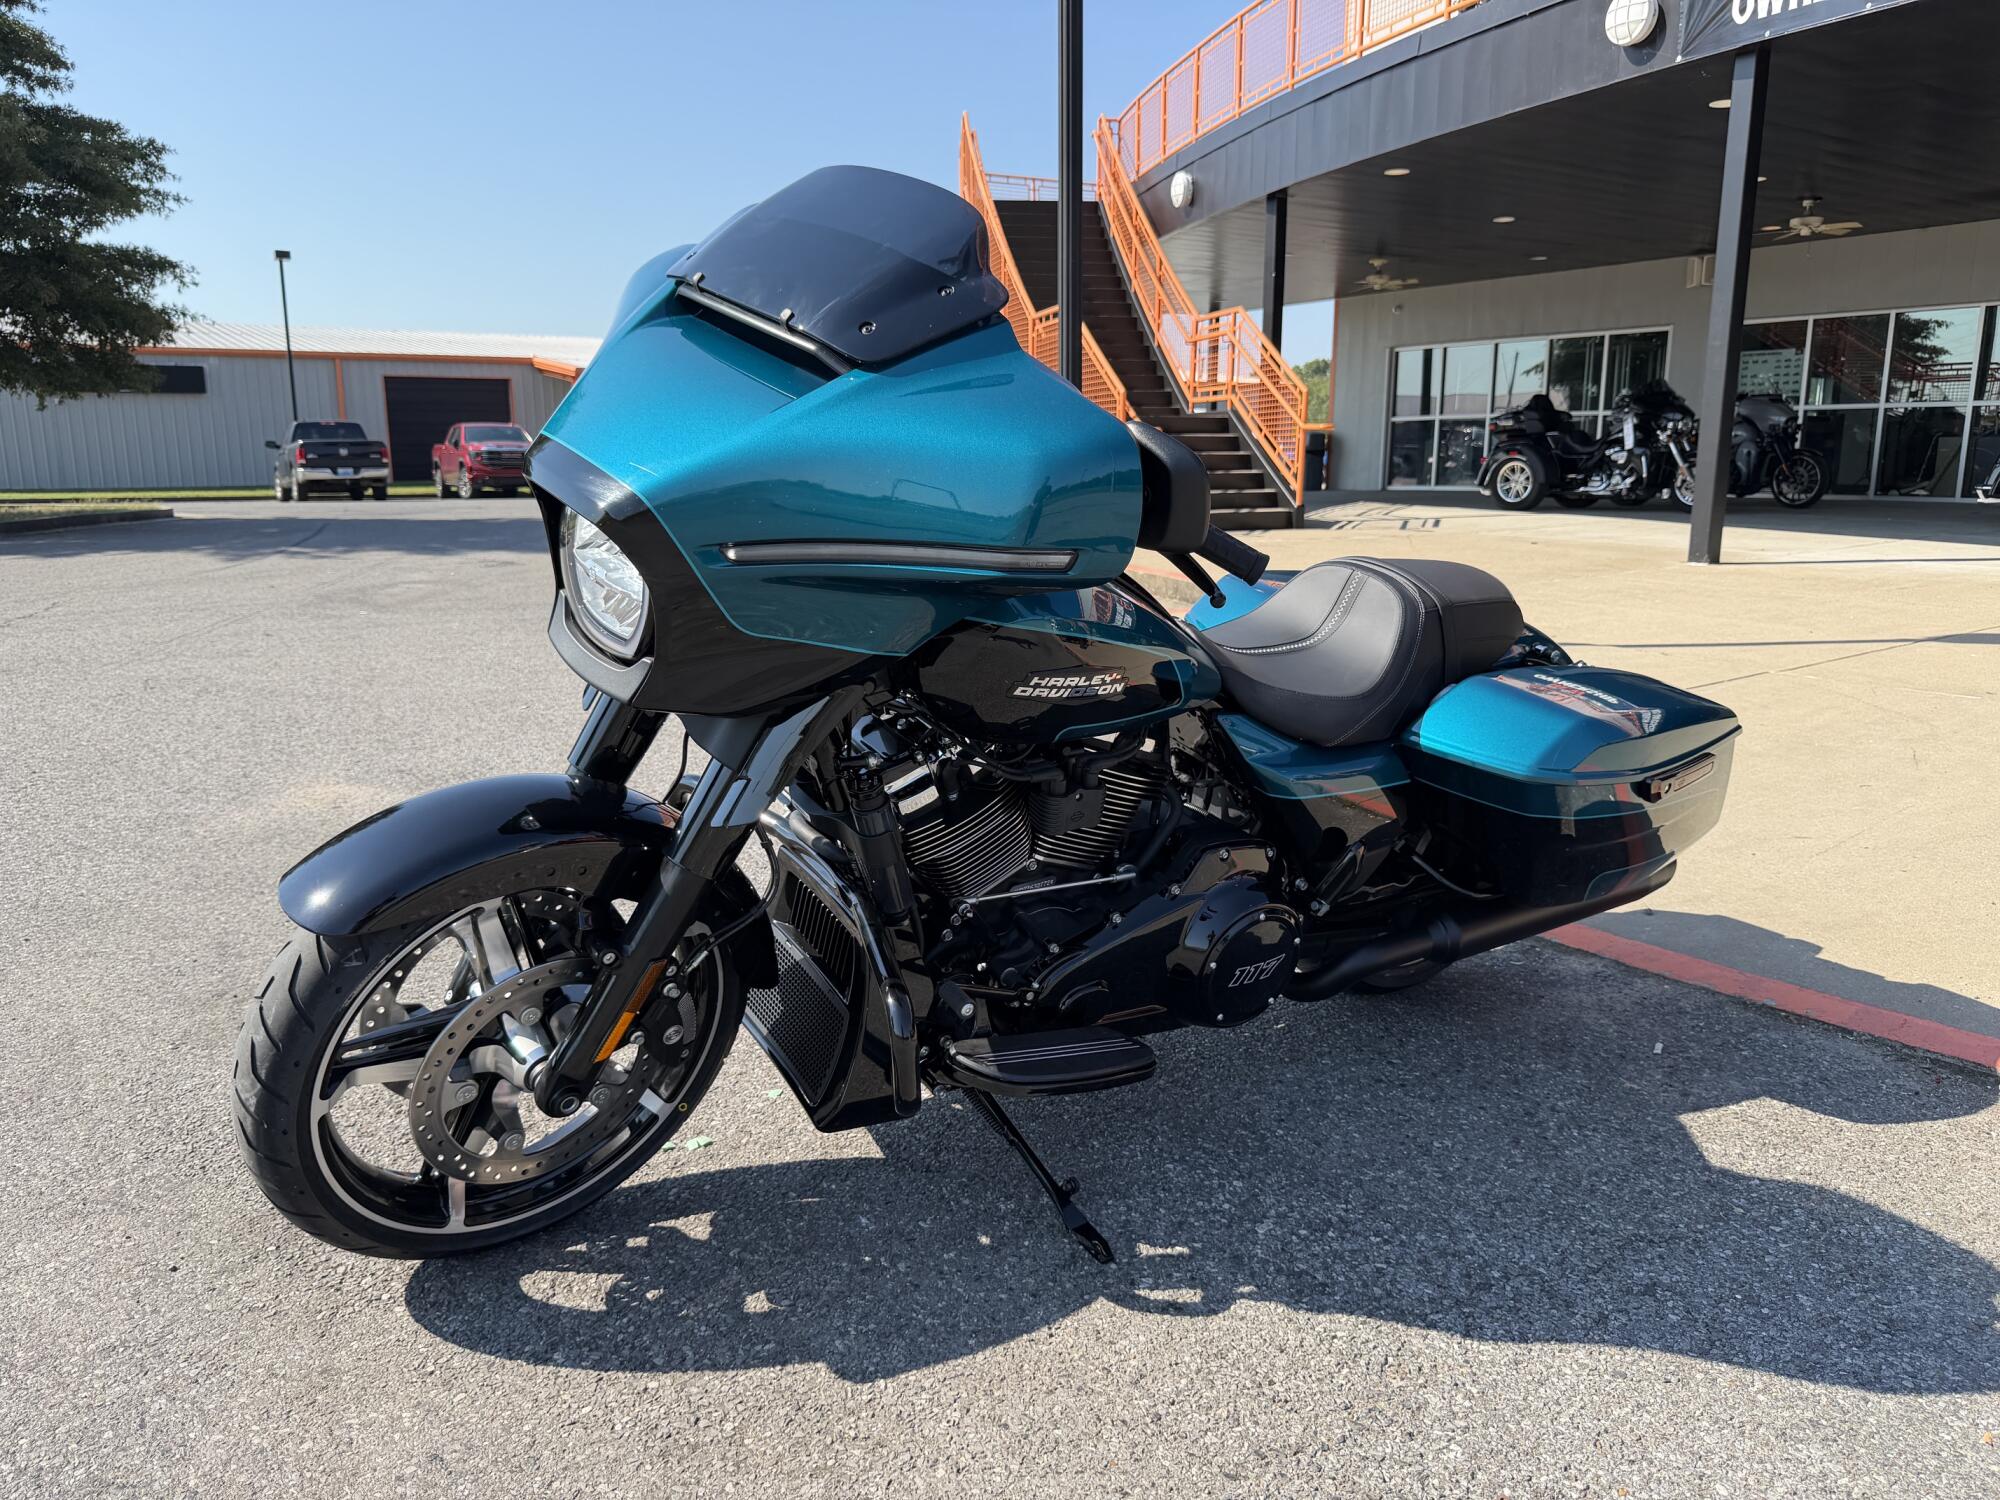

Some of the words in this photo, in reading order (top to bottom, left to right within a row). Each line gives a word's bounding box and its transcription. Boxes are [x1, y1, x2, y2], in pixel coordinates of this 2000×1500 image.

[1029, 673, 1122, 687] HARLEY-
[1014, 683, 1125, 697] DAVIDSON
[1229, 953, 1286, 988] 117
